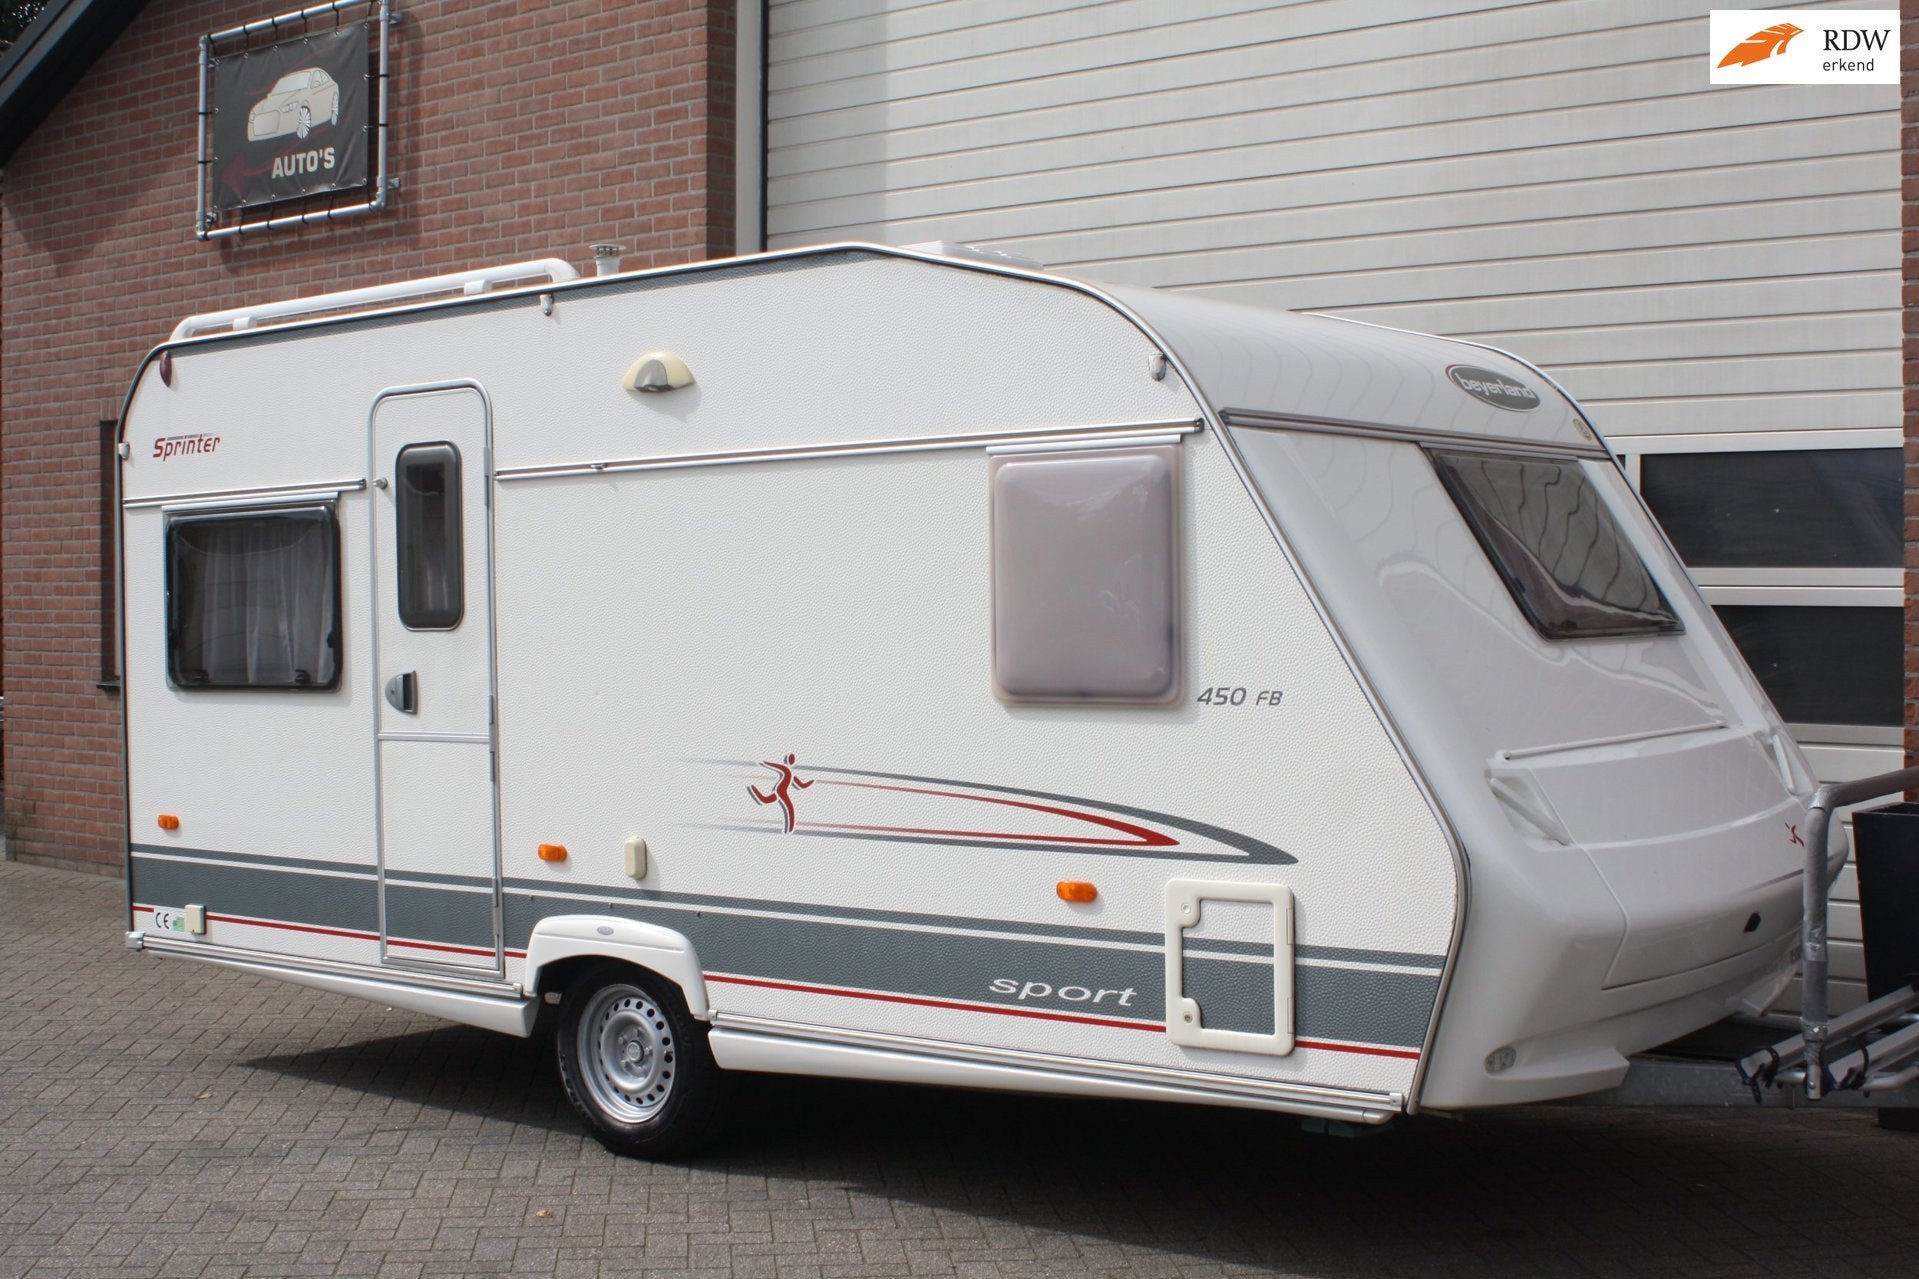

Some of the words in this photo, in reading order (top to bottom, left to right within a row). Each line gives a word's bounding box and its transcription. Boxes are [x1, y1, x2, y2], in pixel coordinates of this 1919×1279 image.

[271, 147, 335, 179] AUTO'S
[1455, 373, 1535, 399] beyerland
[153, 433, 221, 462] Sprinter
[1197, 687, 1247, 706] 450
[1255, 690, 1283, 706] FB
[989, 978, 1138, 1007] sport
